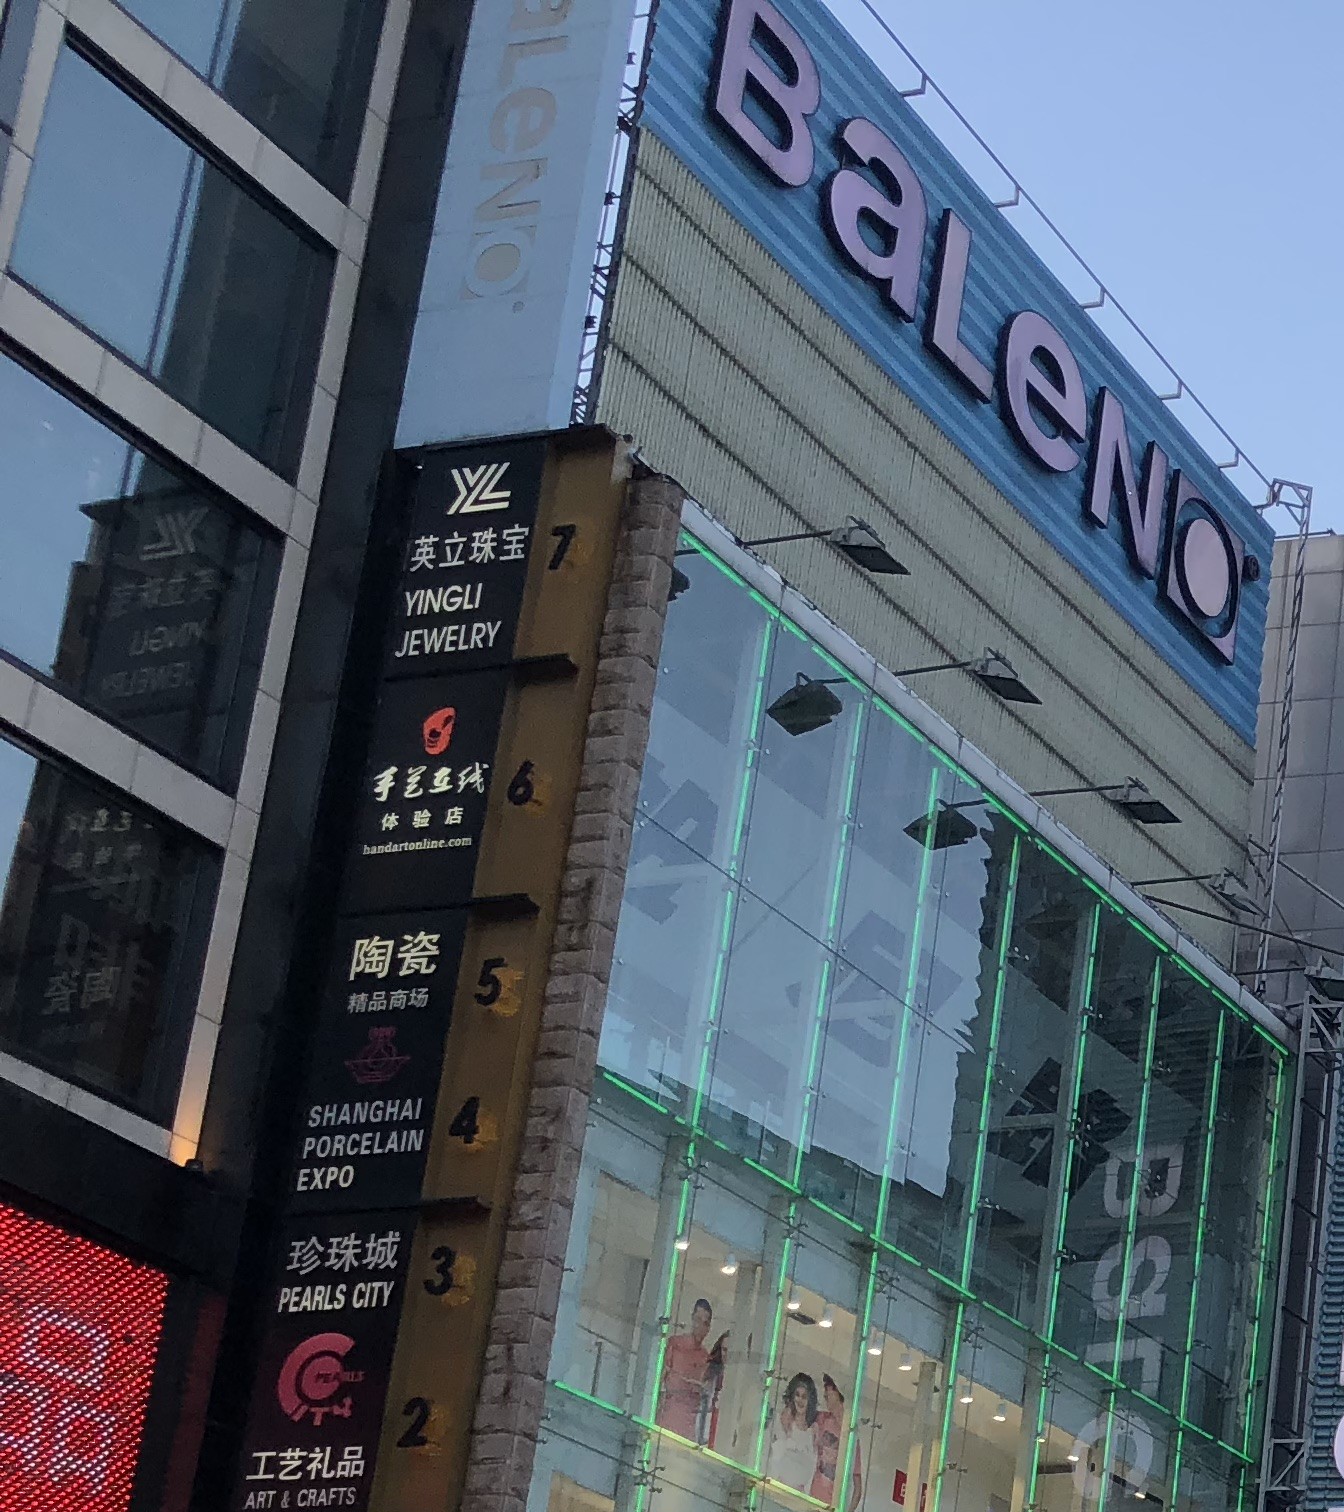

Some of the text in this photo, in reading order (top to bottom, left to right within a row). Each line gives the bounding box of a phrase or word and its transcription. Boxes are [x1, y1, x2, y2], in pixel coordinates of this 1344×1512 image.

[409, 523, 530, 572] 英立珠宝
[548, 524, 576, 571] 7
[404, 583, 483, 617] YINGLI
[394, 621, 501, 658] JEWELRY
[507, 761, 535, 806] 6
[381, 806, 464, 832] 体验店
[362, 836, 472, 856] handartonline.com
[349, 931, 441, 981] 陶瓷
[474, 957, 508, 1006] 5
[347, 987, 429, 1014] 精品商场
[307, 1098, 422, 1128] SHANGHAI
[448, 1096, 480, 1144] 4
[303, 1130, 425, 1159] PORCELAIN
[296, 1165, 354, 1191] EXPO
[286, 1231, 400, 1274] 珍珠城
[424, 1245, 457, 1296] 3
[278, 1281, 394, 1313] PEARLS CITY
[396, 1397, 432, 1448] 2
[246, 1446, 365, 1481] 工艺礼品
[243, 1487, 357, 1510] ART & CRAFTS
